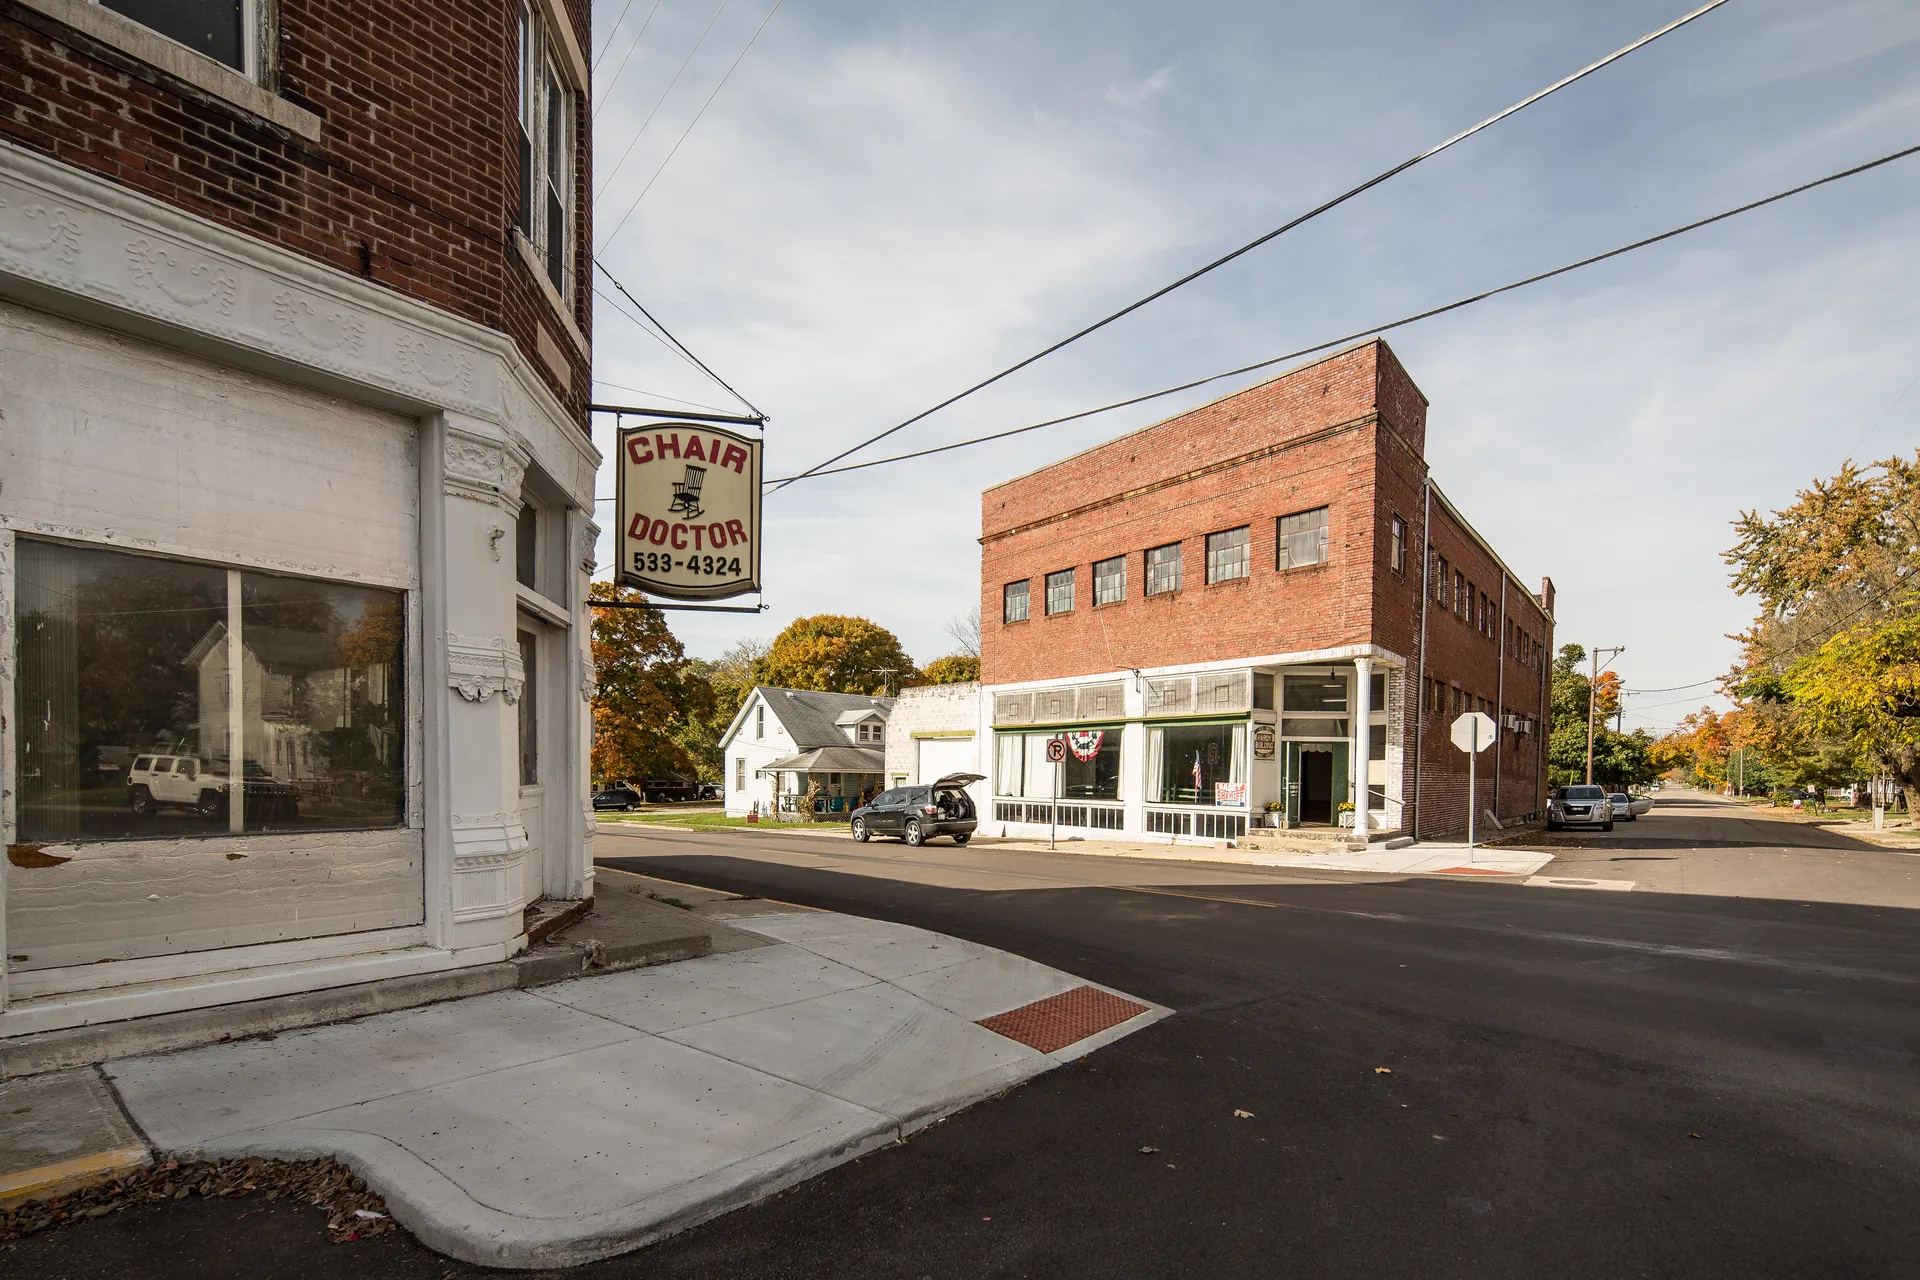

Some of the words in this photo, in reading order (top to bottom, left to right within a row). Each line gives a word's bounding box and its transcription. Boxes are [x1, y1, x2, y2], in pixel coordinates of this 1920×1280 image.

[626, 433, 748, 474] CHAIR
[627, 512, 748, 551] DOCTOR
[633, 551, 742, 577] 533-4324
[1255, 741, 1274, 749] BUILDING
[1217, 790, 1244, 801] SHERIFF
